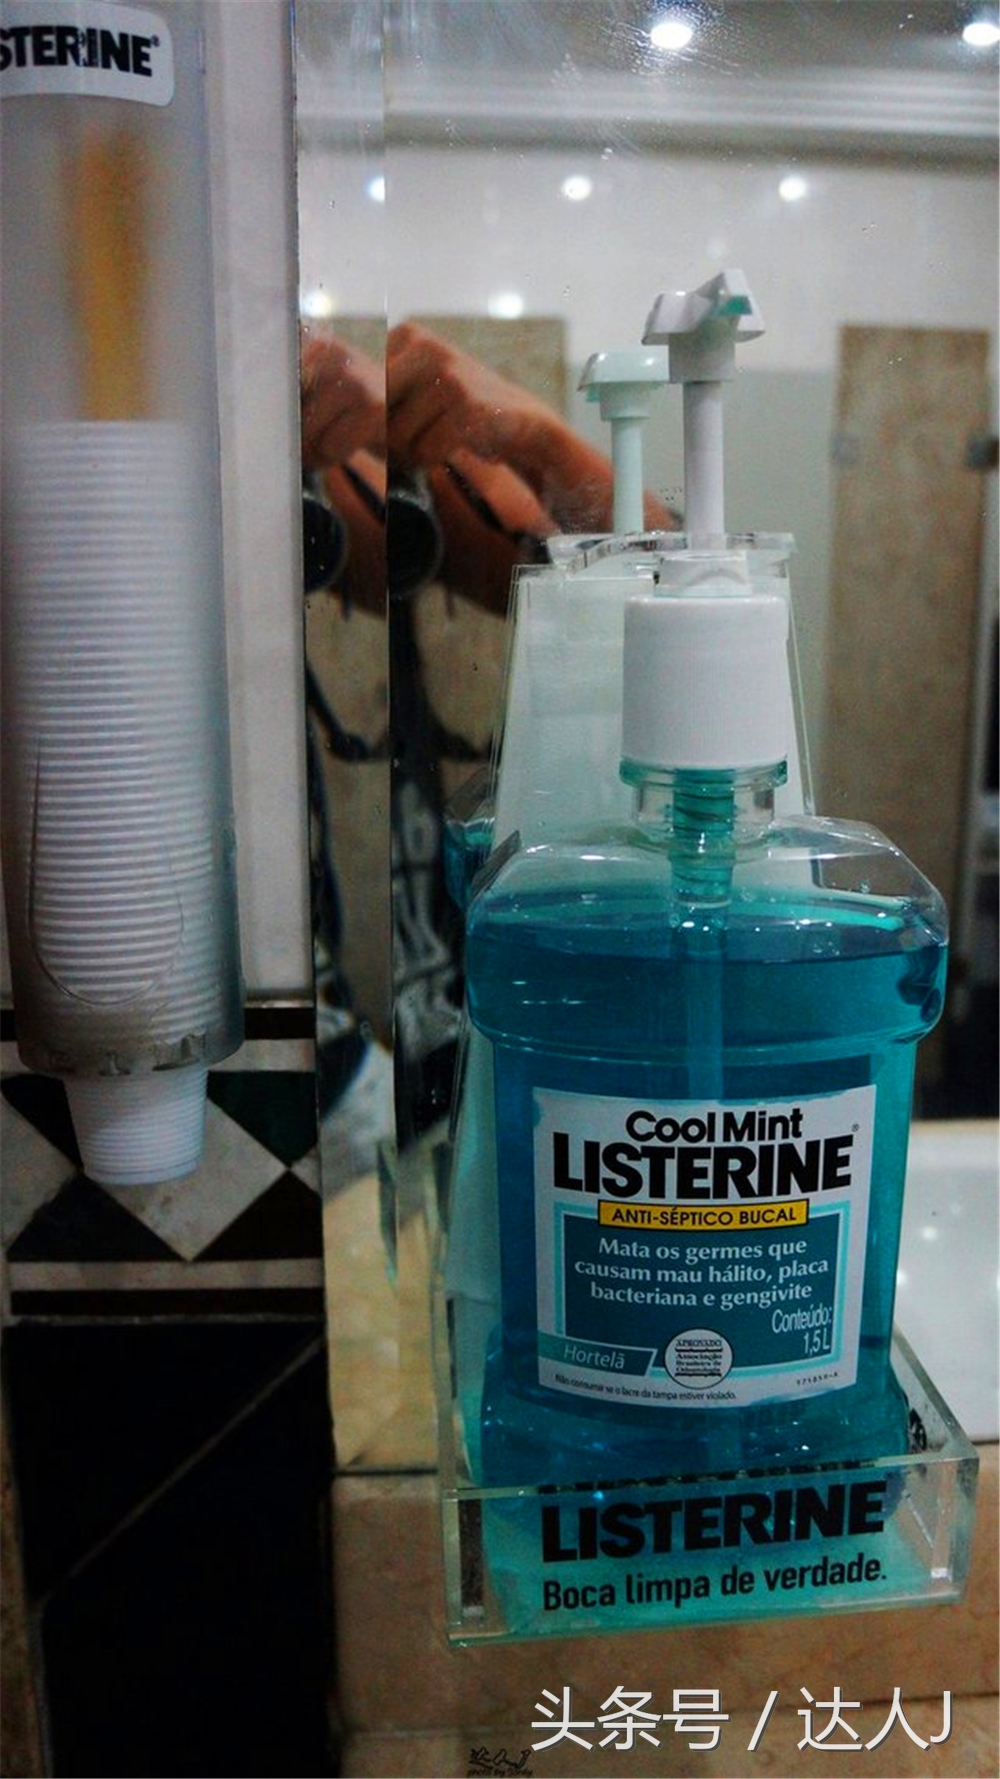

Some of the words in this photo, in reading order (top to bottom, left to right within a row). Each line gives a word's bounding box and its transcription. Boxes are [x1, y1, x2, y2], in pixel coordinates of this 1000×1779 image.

[626, 1110, 716, 1143] Cool
[723, 1107, 803, 1142] Mint
[612, 1207, 733, 1226] ANTI-SÉPTICO
[739, 1209, 796, 1223] BUCAL
[599, 1237, 650, 1259] Mata
[655, 1245, 680, 1260] os
[685, 1243, 763, 1265] germes
[768, 1238, 807, 1262] que
[574, 1260, 650, 1281] causam
[656, 1267, 702, 1283] mau
[708, 1264, 772, 1284] hálito,
[778, 1258, 829, 1284] placa
[591, 1280, 697, 1306] bacteriana
[702, 1294, 716, 1307] e
[720, 1284, 813, 1311] gengivite
[771, 1302, 833, 1334] Conteúdo:
[563, 1344, 626, 1370] Hortelã
[541, 1480, 887, 1563] LISTERINE
[543, 1580, 616, 1611] Boca
[626, 1573, 710, 1608] limpa
[720, 1565, 755, 1596] de
[763, 1553, 887, 1592] verdade.
